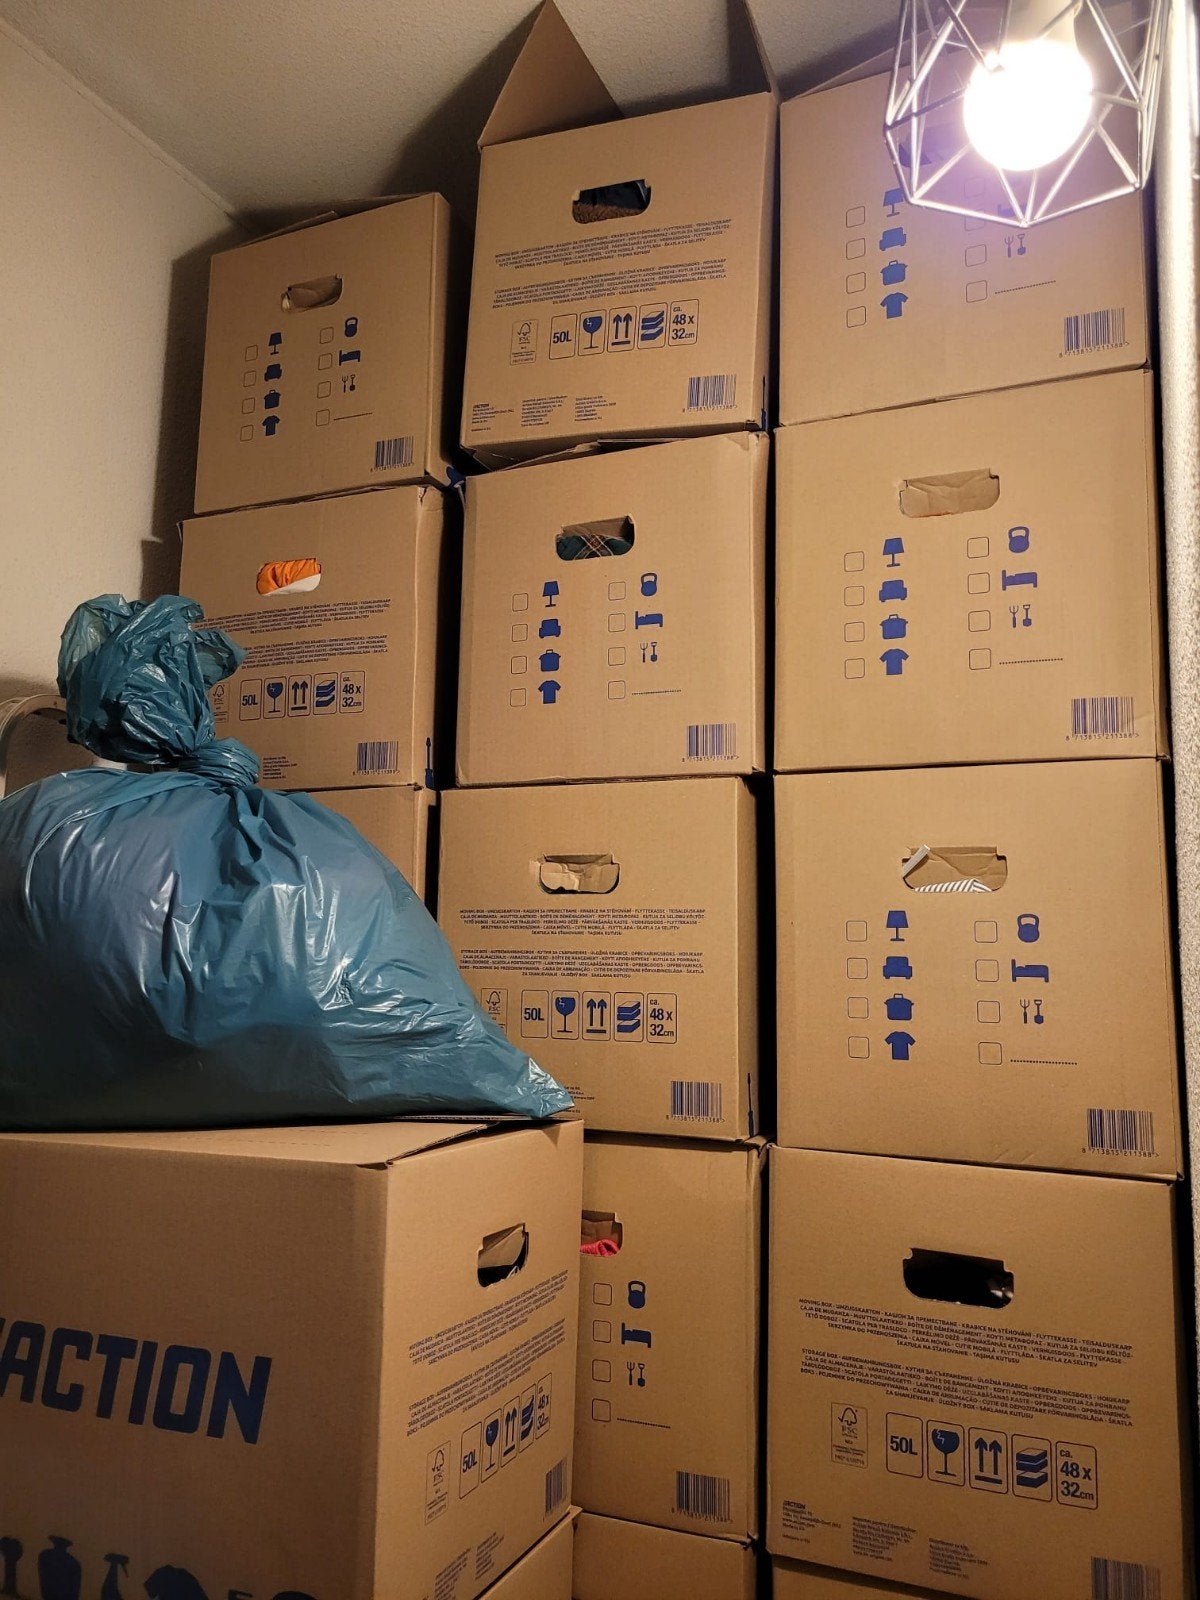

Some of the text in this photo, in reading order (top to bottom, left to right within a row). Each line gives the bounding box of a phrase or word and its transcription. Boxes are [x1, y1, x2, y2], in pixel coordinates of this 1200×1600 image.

[672, 314, 695, 326] 48 x
[553, 330, 572, 344] 50L
[672, 328, 695, 340] 32cm
[342, 684, 361, 694] 48 x
[242, 694, 258, 706] 50L
[524, 1007, 544, 1021] 50L
[650, 1008, 673, 1021] 48 x
[649, 1024, 675, 1037] 32cm
[0, 1319, 272, 1445] ACTION
[890, 1435, 918, 1455] 50L
[1060, 1449, 1073, 1458] ca.
[462, 1449, 478, 1473] 50L
[1060, 1461, 1092, 1481] 48 x
[1061, 1480, 1094, 1500] 32cm
